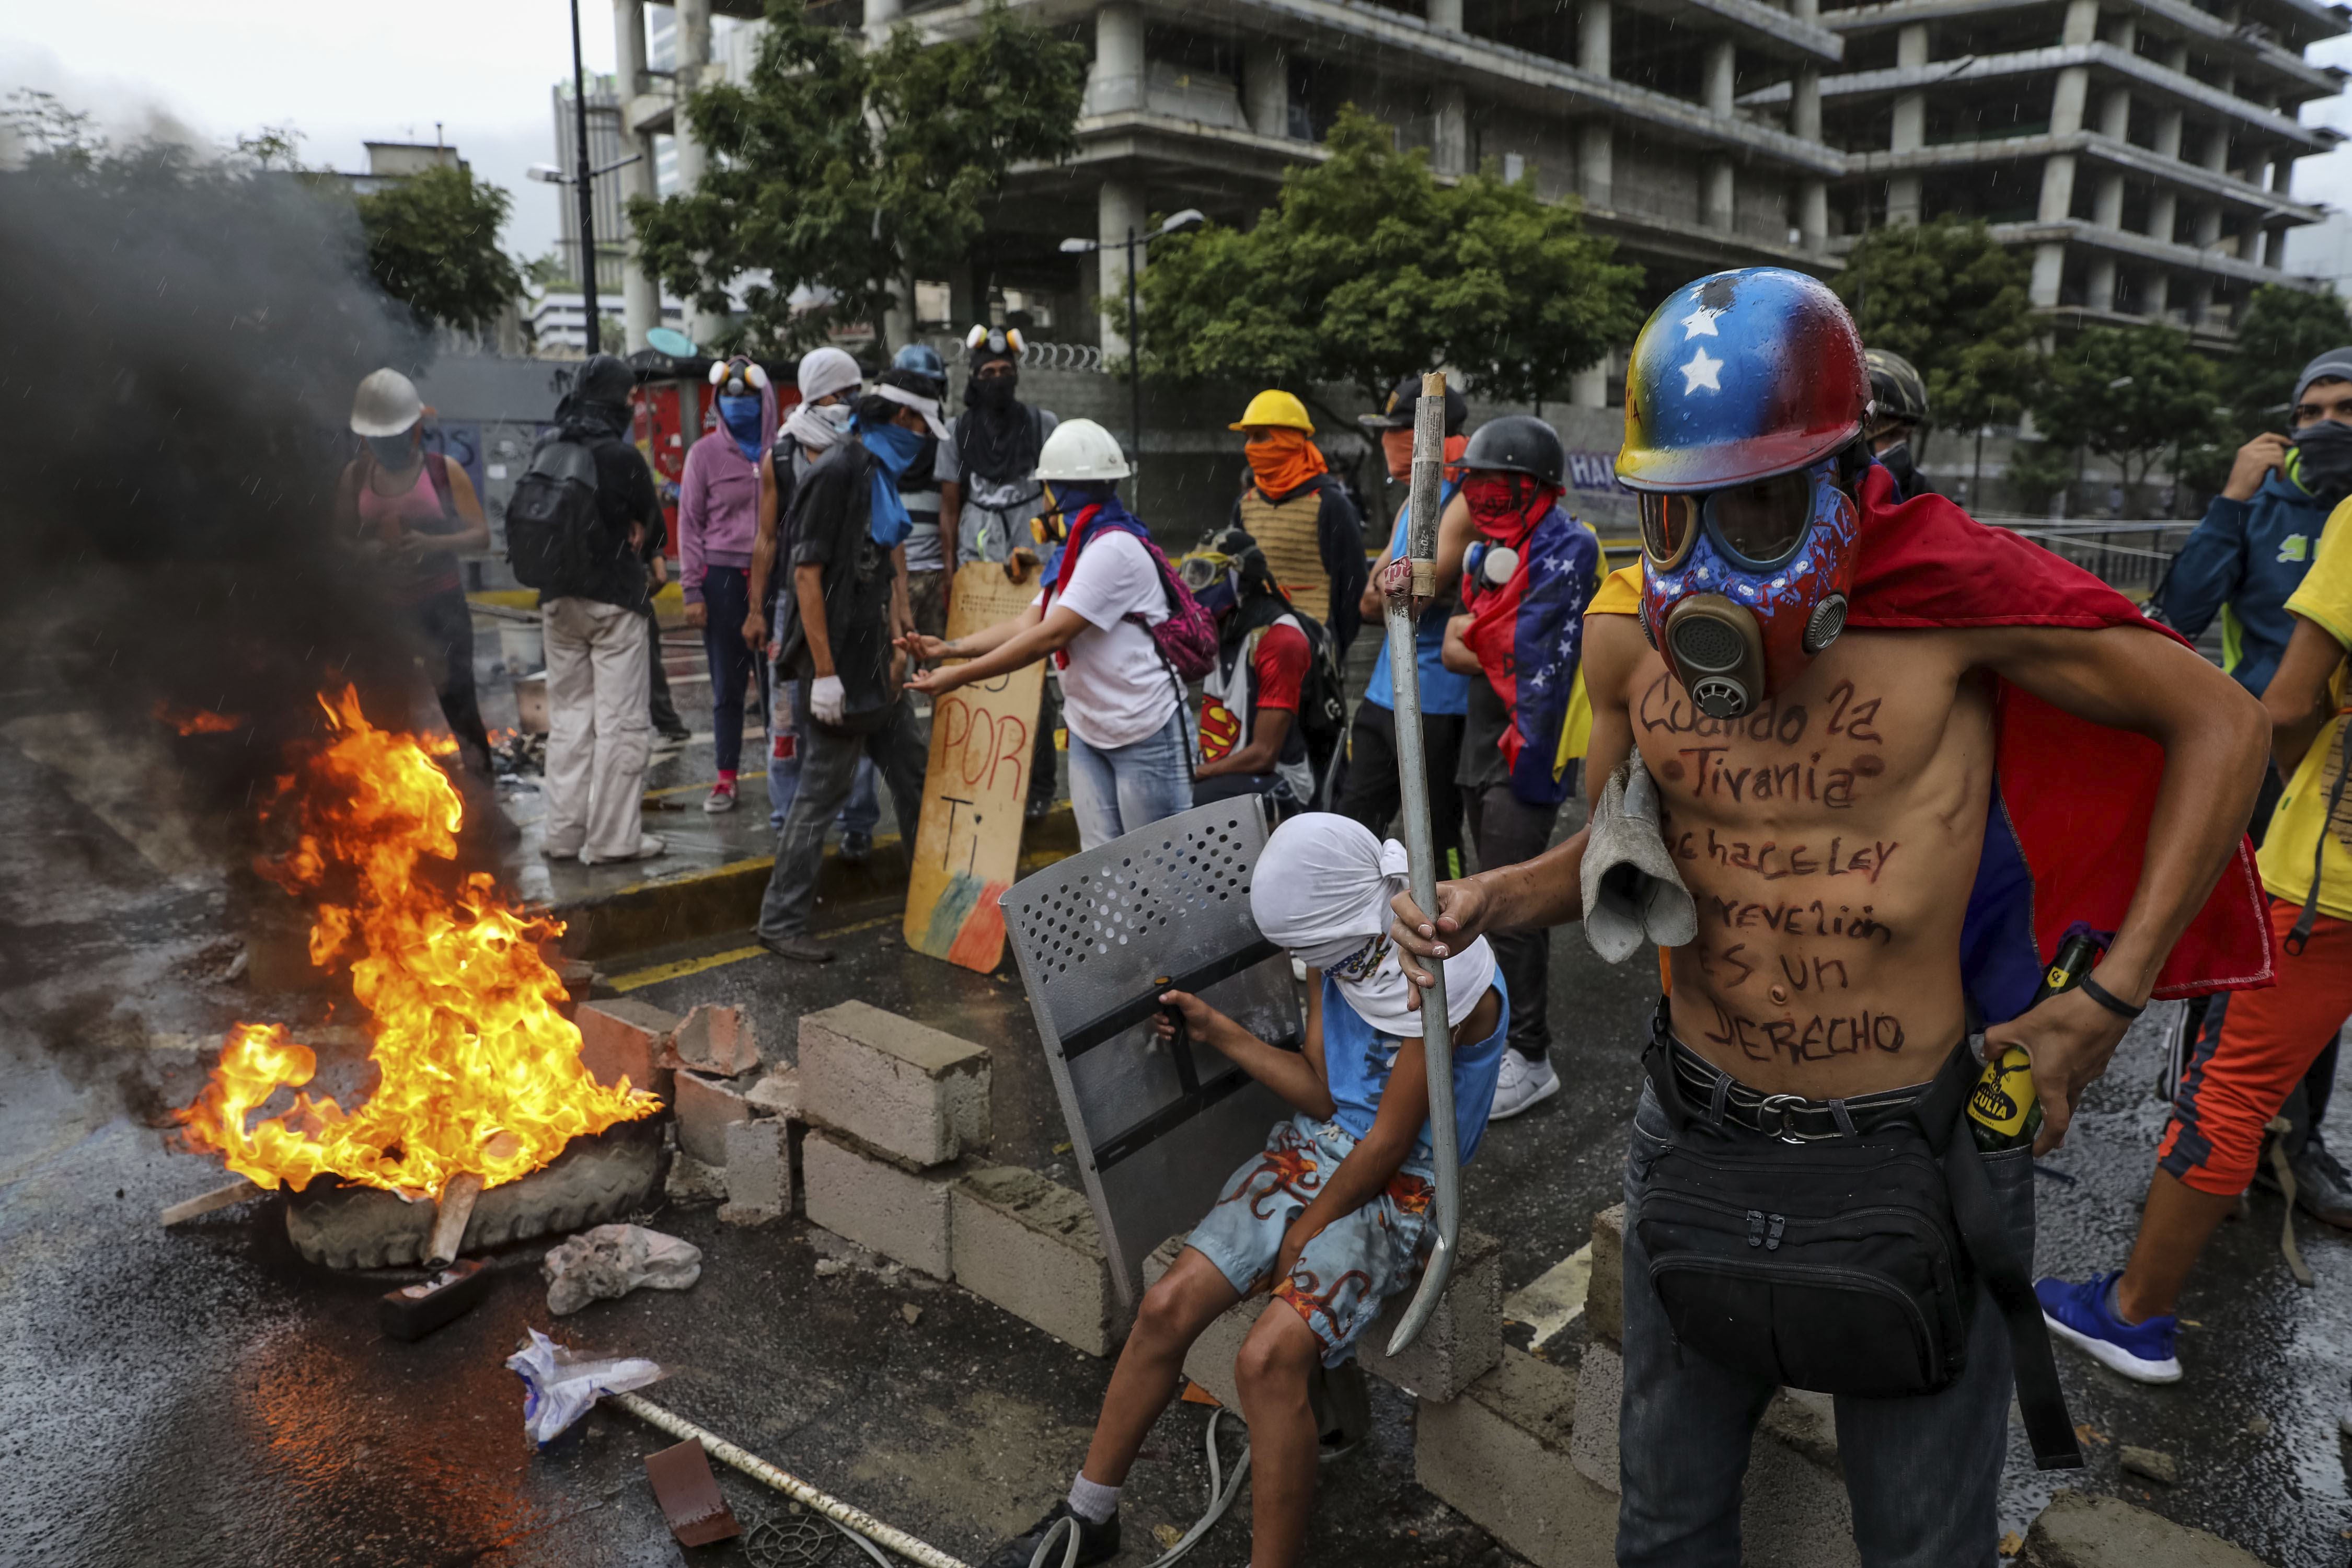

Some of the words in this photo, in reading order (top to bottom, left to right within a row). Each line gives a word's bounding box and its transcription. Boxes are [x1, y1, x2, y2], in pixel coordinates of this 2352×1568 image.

[941, 698, 1026, 800] POR
[941, 795, 982, 878] Ti
[1705, 995, 1905, 1064] DERECHO
[1973, 1090, 2007, 1120] ZULIA
